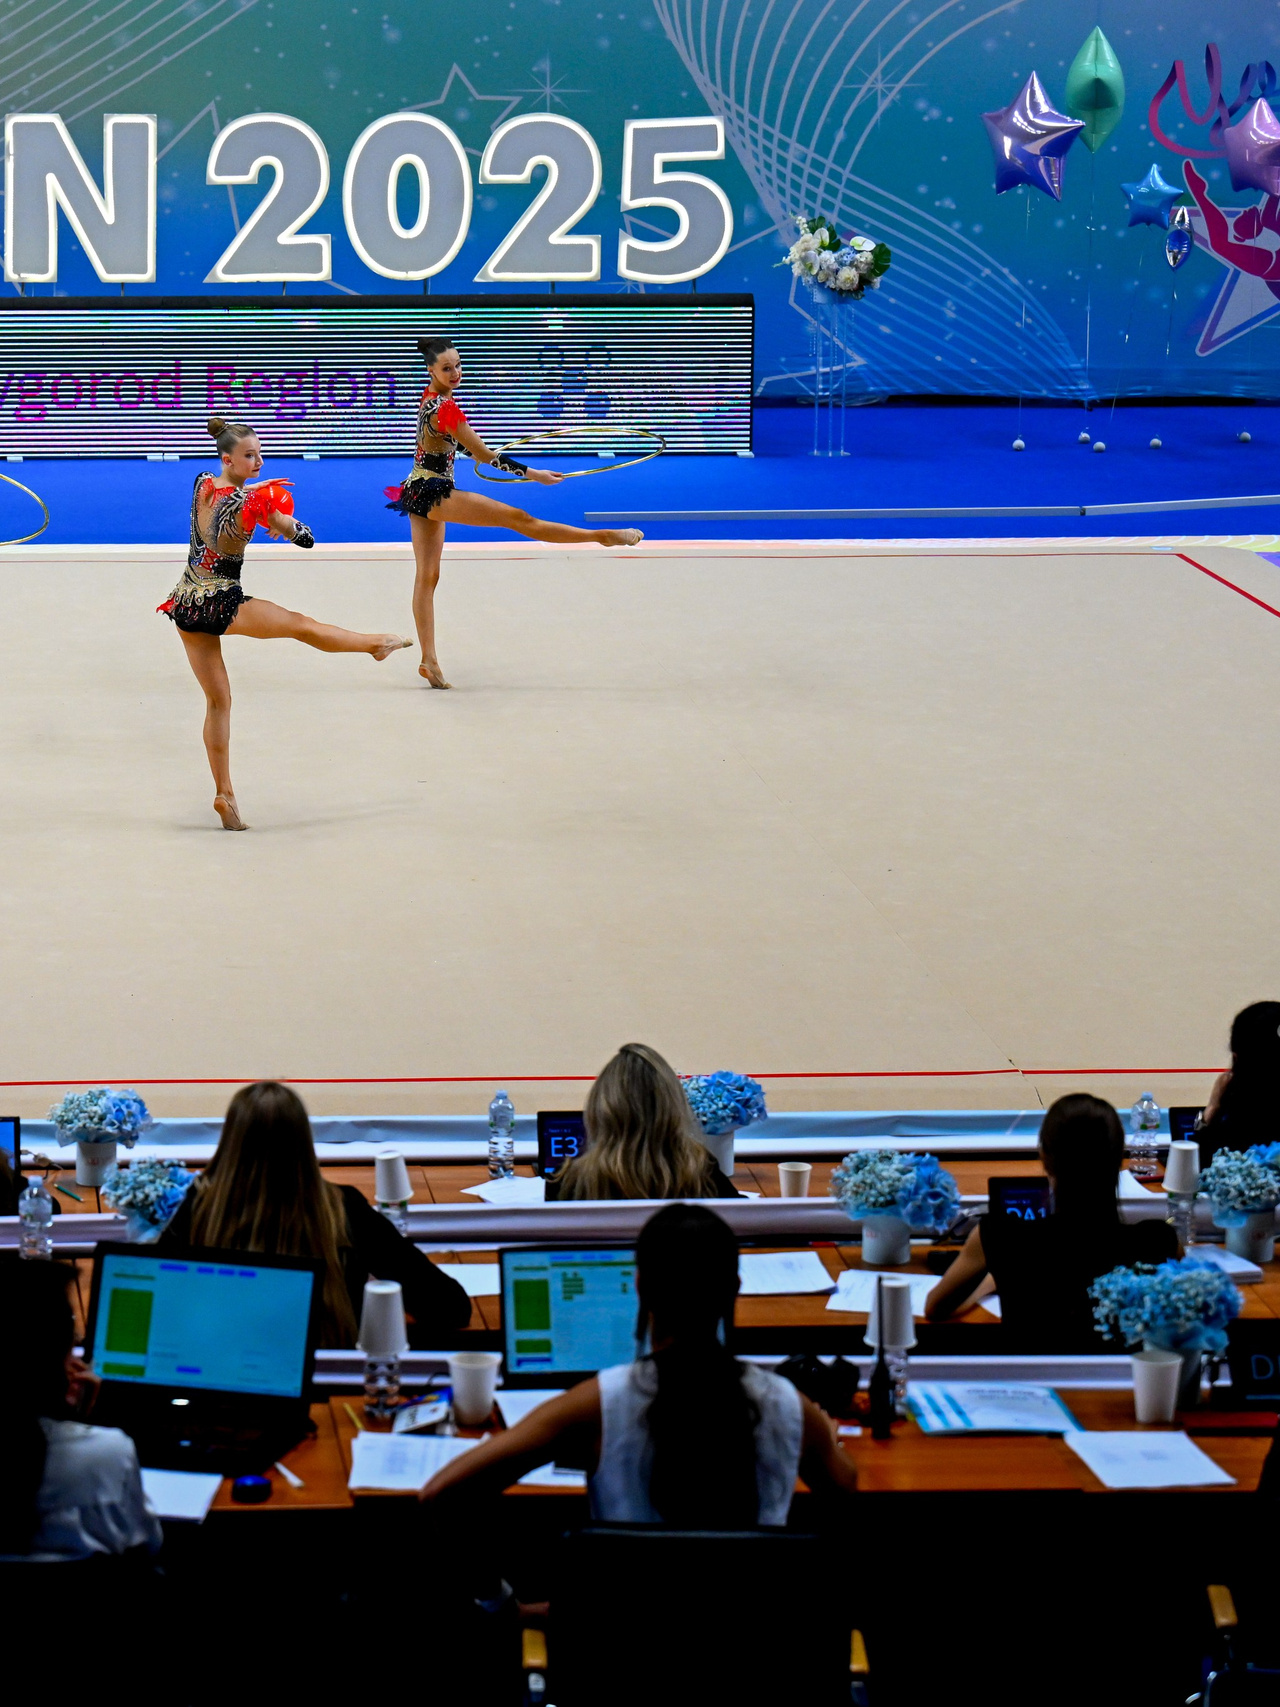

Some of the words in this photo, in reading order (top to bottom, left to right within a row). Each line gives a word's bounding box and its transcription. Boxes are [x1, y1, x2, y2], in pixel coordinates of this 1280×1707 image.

[204, 111, 734, 285] 2025
[207, 359, 397, 420] Region
[550, 1136, 579, 1158] E3
[1251, 1354, 1280, 1380] D
